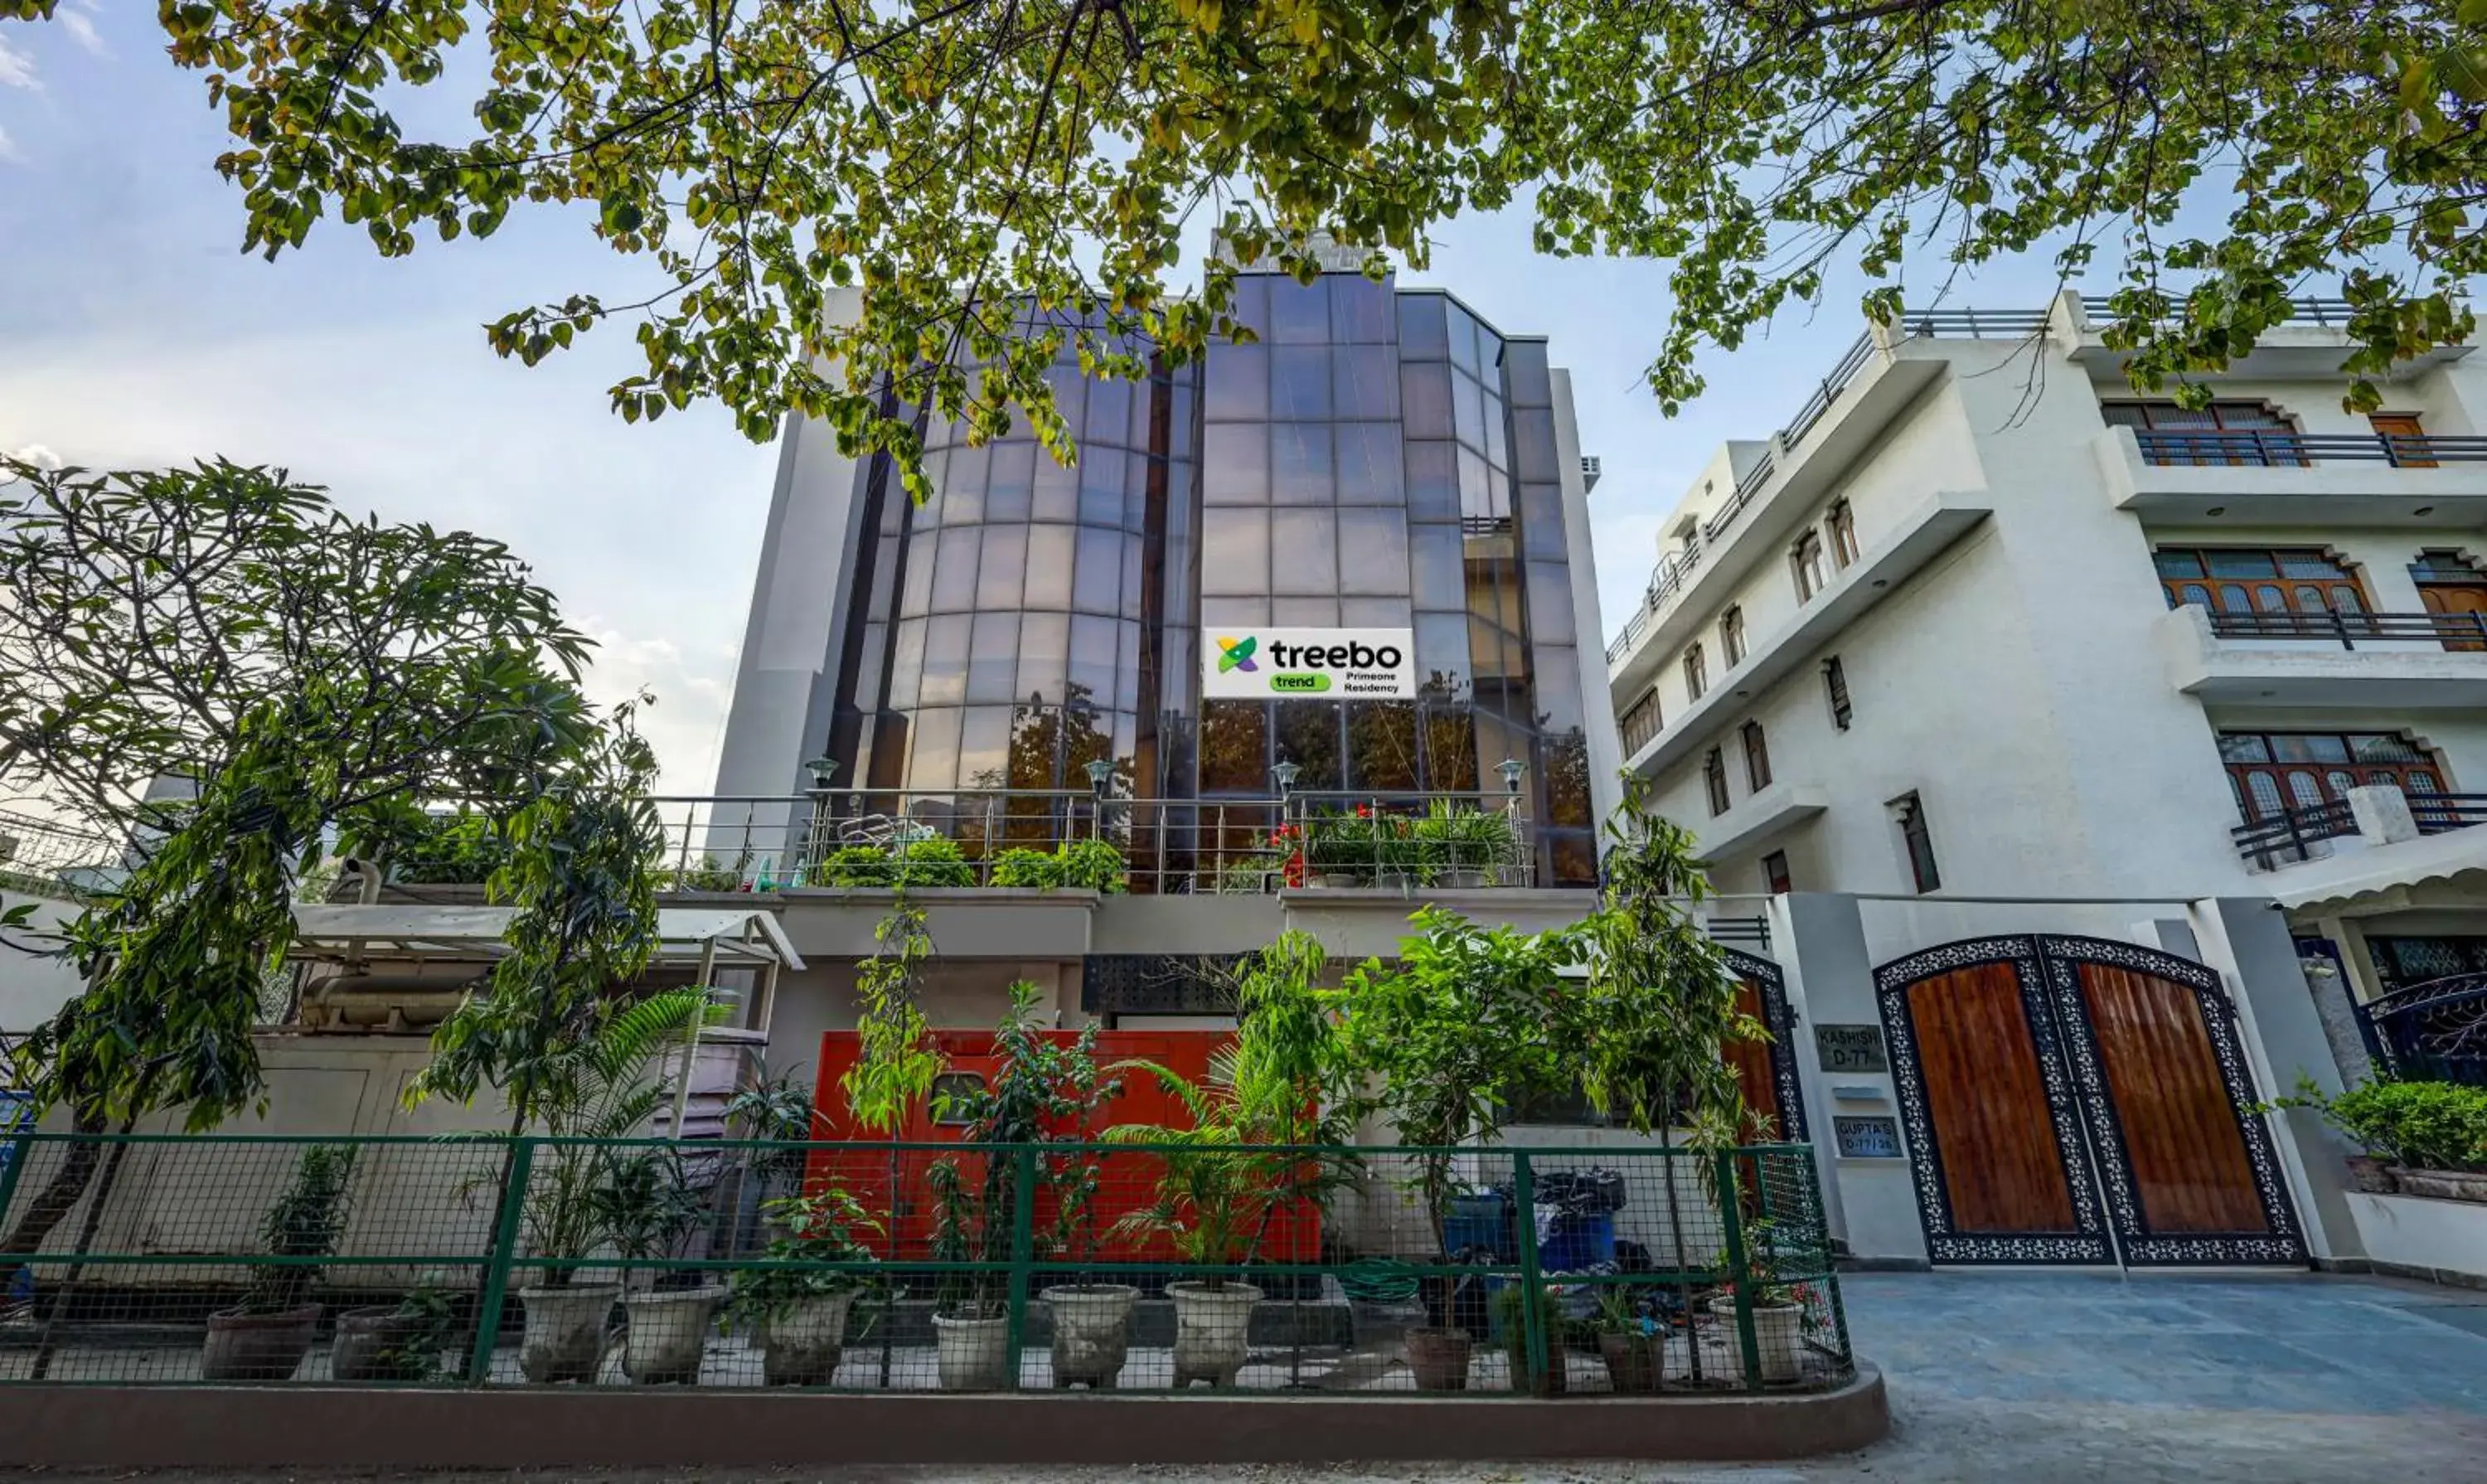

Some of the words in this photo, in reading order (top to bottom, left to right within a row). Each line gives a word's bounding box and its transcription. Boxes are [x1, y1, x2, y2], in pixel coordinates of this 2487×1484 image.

[1269, 640, 1402, 669] treebo
[1276, 676, 1315, 687] trend
[1346, 672, 1396, 681] Primeone
[1345, 683, 1399, 694] Residency
[1819, 1031, 1878, 1045] KASHISH
[1833, 1049, 1869, 1066] D-77
